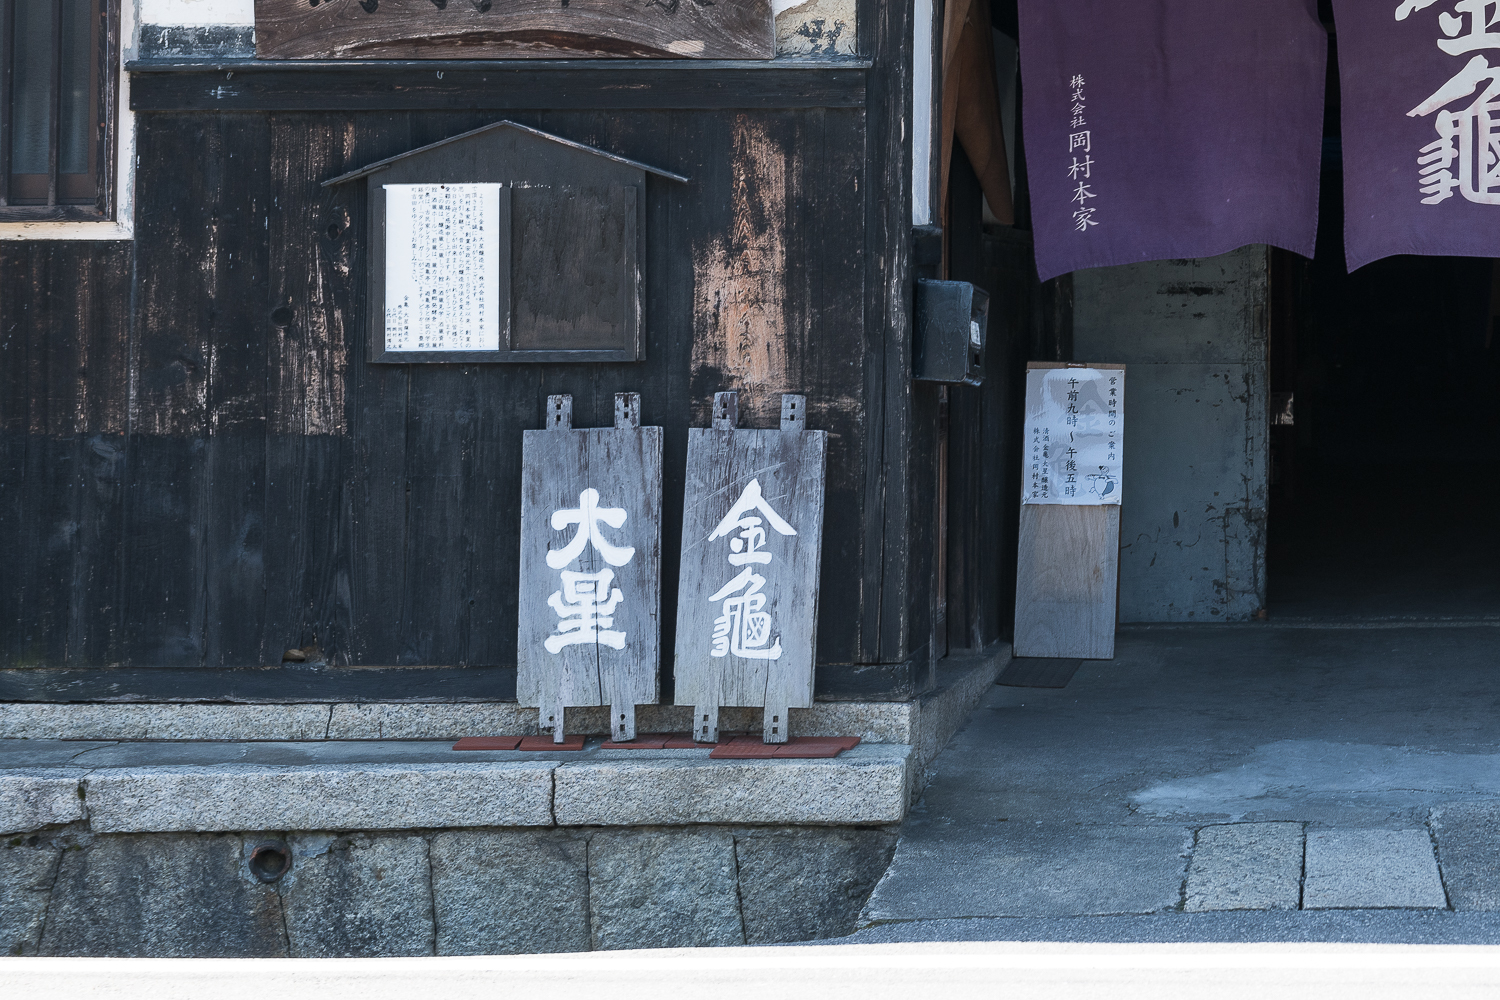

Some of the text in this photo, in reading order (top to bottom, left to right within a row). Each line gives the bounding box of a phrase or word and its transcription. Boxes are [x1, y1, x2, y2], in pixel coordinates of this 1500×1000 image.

[1107, 376, 1118, 461] 営業時間のご案内
